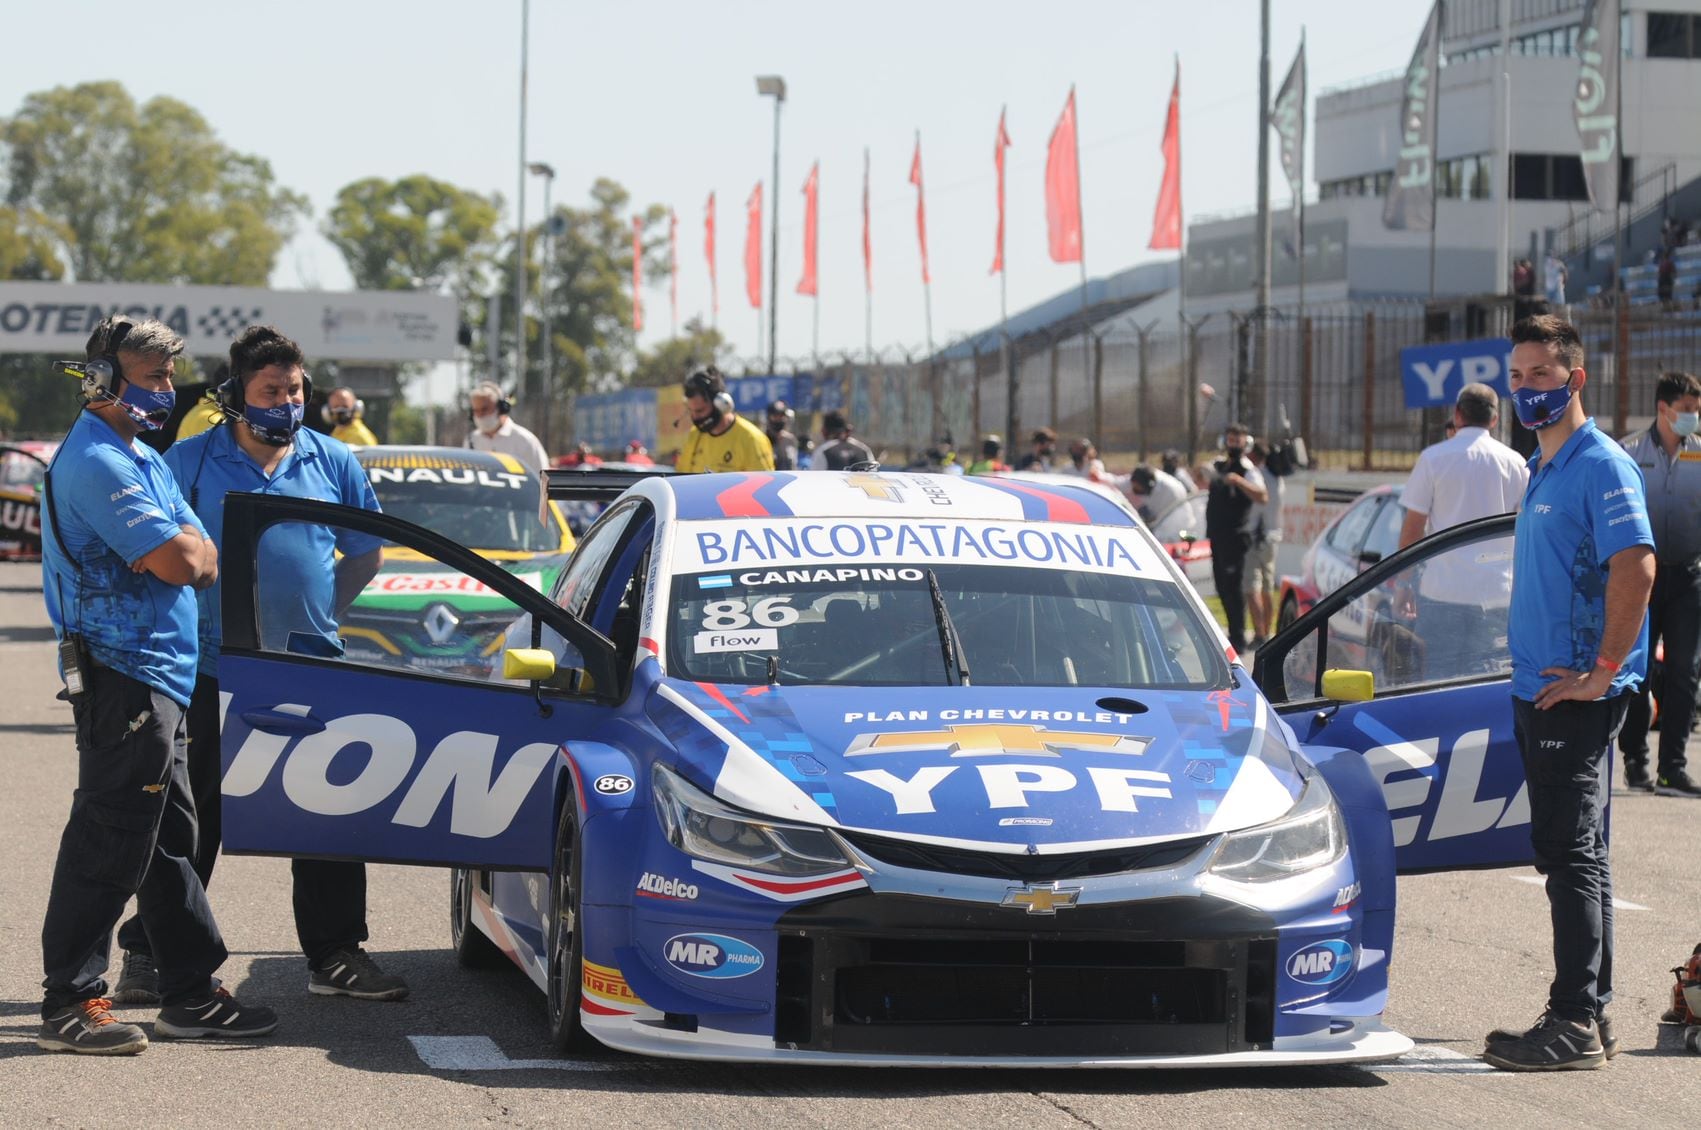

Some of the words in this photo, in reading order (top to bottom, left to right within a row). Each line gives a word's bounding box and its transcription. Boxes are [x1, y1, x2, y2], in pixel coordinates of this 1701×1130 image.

[1412, 354, 1514, 401] YP
[1525, 392, 1549, 406] YPF
[365, 467, 528, 489] NAULT
[696, 523, 1142, 572] BANCOPATAGONIA
[382, 575, 500, 593] Castr
[739, 567, 924, 586] CANAPINO
[701, 597, 800, 631] 86
[710, 635, 761, 648] flow
[844, 710, 929, 724] PLAN
[939, 709, 1133, 725] CHEVROLET
[1538, 739, 1566, 749] YPF
[598, 777, 630, 791] 86
[843, 763, 1173, 815] YPF
[637, 871, 698, 900] ACDelco
[669, 940, 719, 966] MR
[727, 952, 760, 965] PHARMA
[1291, 951, 1333, 976] MR
[583, 972, 640, 999] IREL
